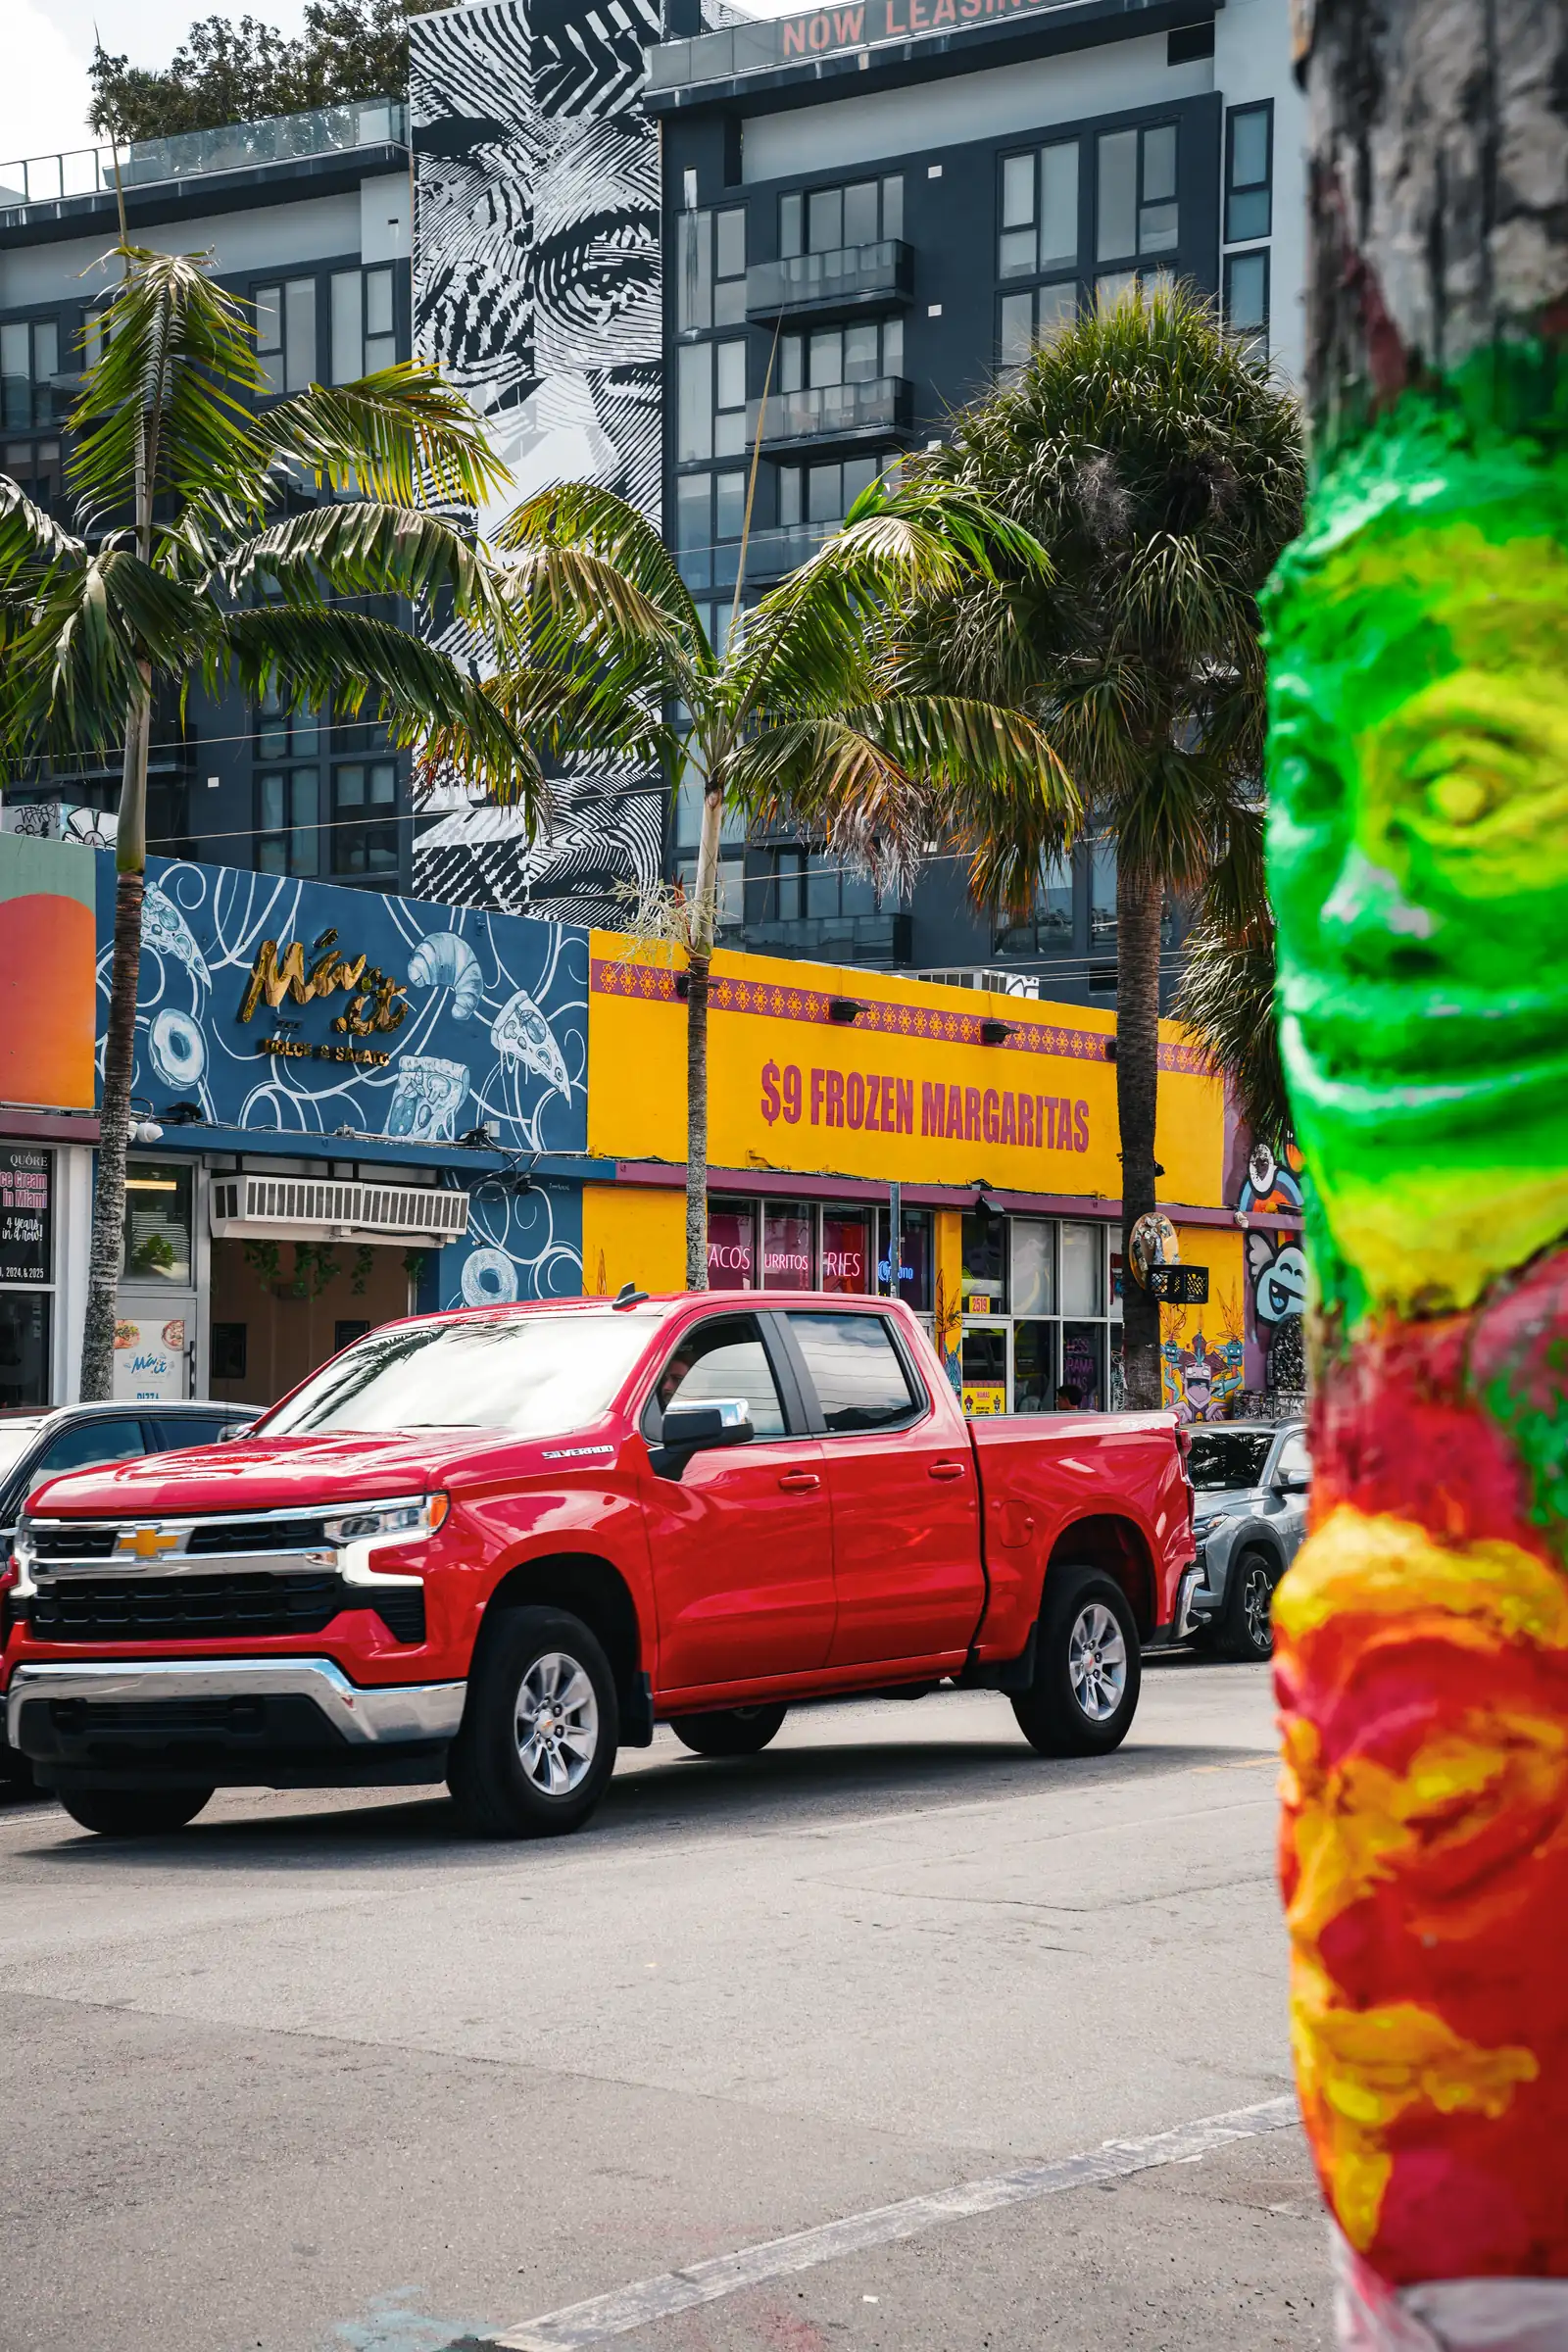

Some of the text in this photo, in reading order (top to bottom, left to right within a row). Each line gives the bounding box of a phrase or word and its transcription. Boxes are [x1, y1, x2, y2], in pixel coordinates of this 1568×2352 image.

[783, 6, 864, 56] NOW
[265, 1038, 390, 1067] DOLCE & SALATO
[760, 1058, 1090, 1153] $9 FROZEN MARGARITAS
[0, 1169, 48, 1190] ce Cream
[3, 1188, 48, 1208] in Miami
[2, 1227, 13, 1240] in
[22, 1224, 43, 1242] row!
[6, 1216, 39, 1231] 4 years
[707, 1245, 751, 1270] ACOS
[764, 1253, 808, 1271] URRITOS
[23, 1267, 28, 1278] &
[28, 1267, 44, 1279] 2025
[971, 1297, 988, 1312] 2519
[541, 1445, 614, 1460] SILVERADO
